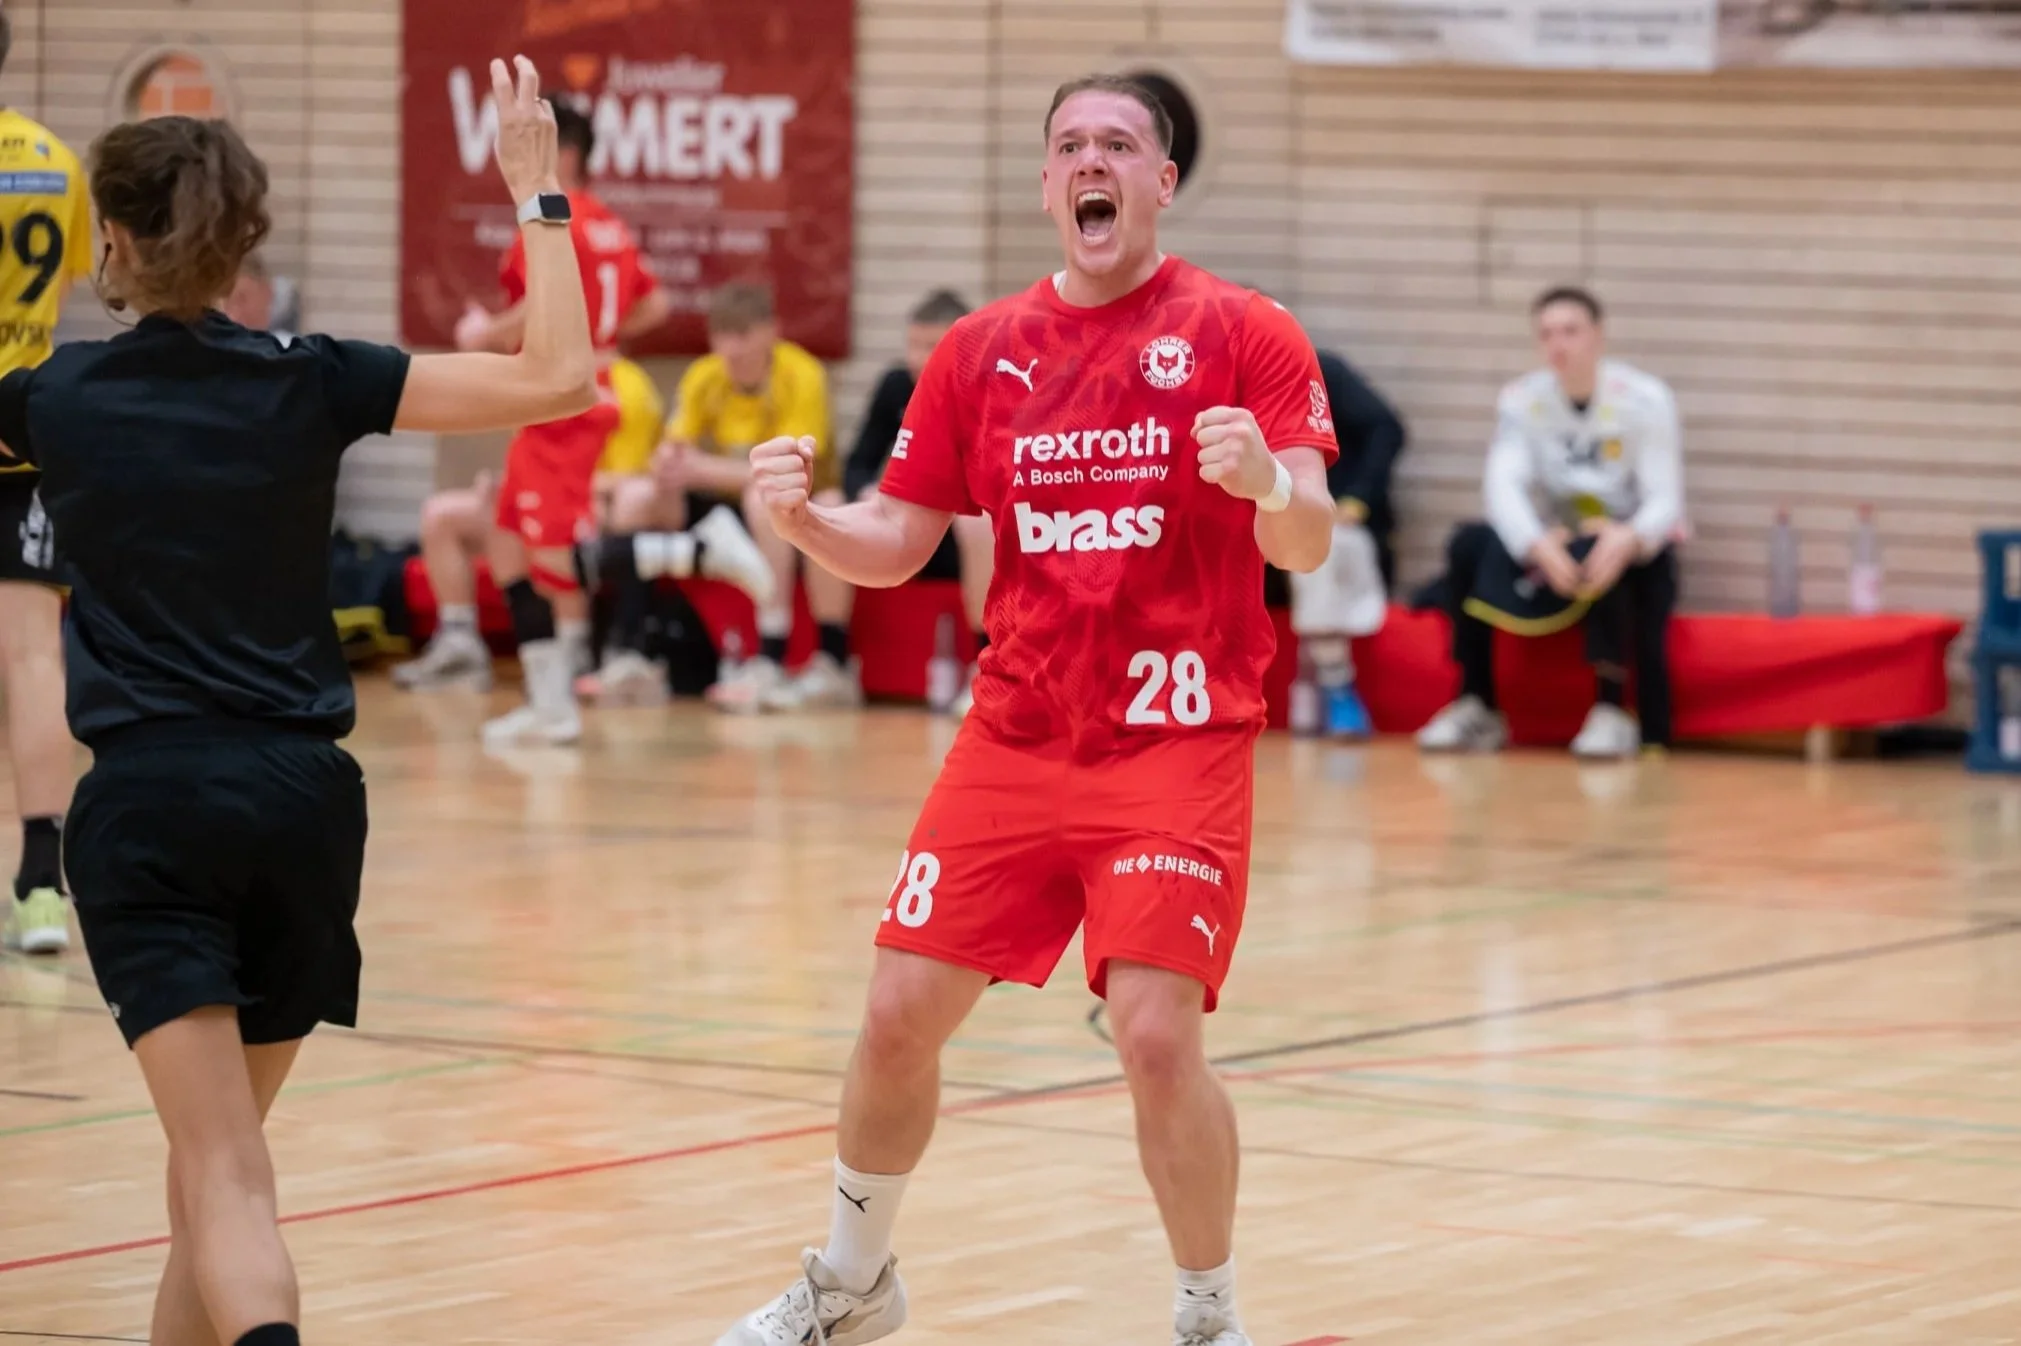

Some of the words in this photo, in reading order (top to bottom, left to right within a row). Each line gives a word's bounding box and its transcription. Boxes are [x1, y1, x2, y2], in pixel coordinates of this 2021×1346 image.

[1013, 416, 1170, 465] rexroth
[1013, 471, 1024, 487] A
[1031, 467, 1084, 486] Bosch
[1090, 465, 1169, 483] Company
[1014, 501, 1165, 554] brass
[1125, 650, 1211, 726] 28
[1113, 857, 1136, 876] DIE
[1153, 854, 1223, 887] ENERGIE
